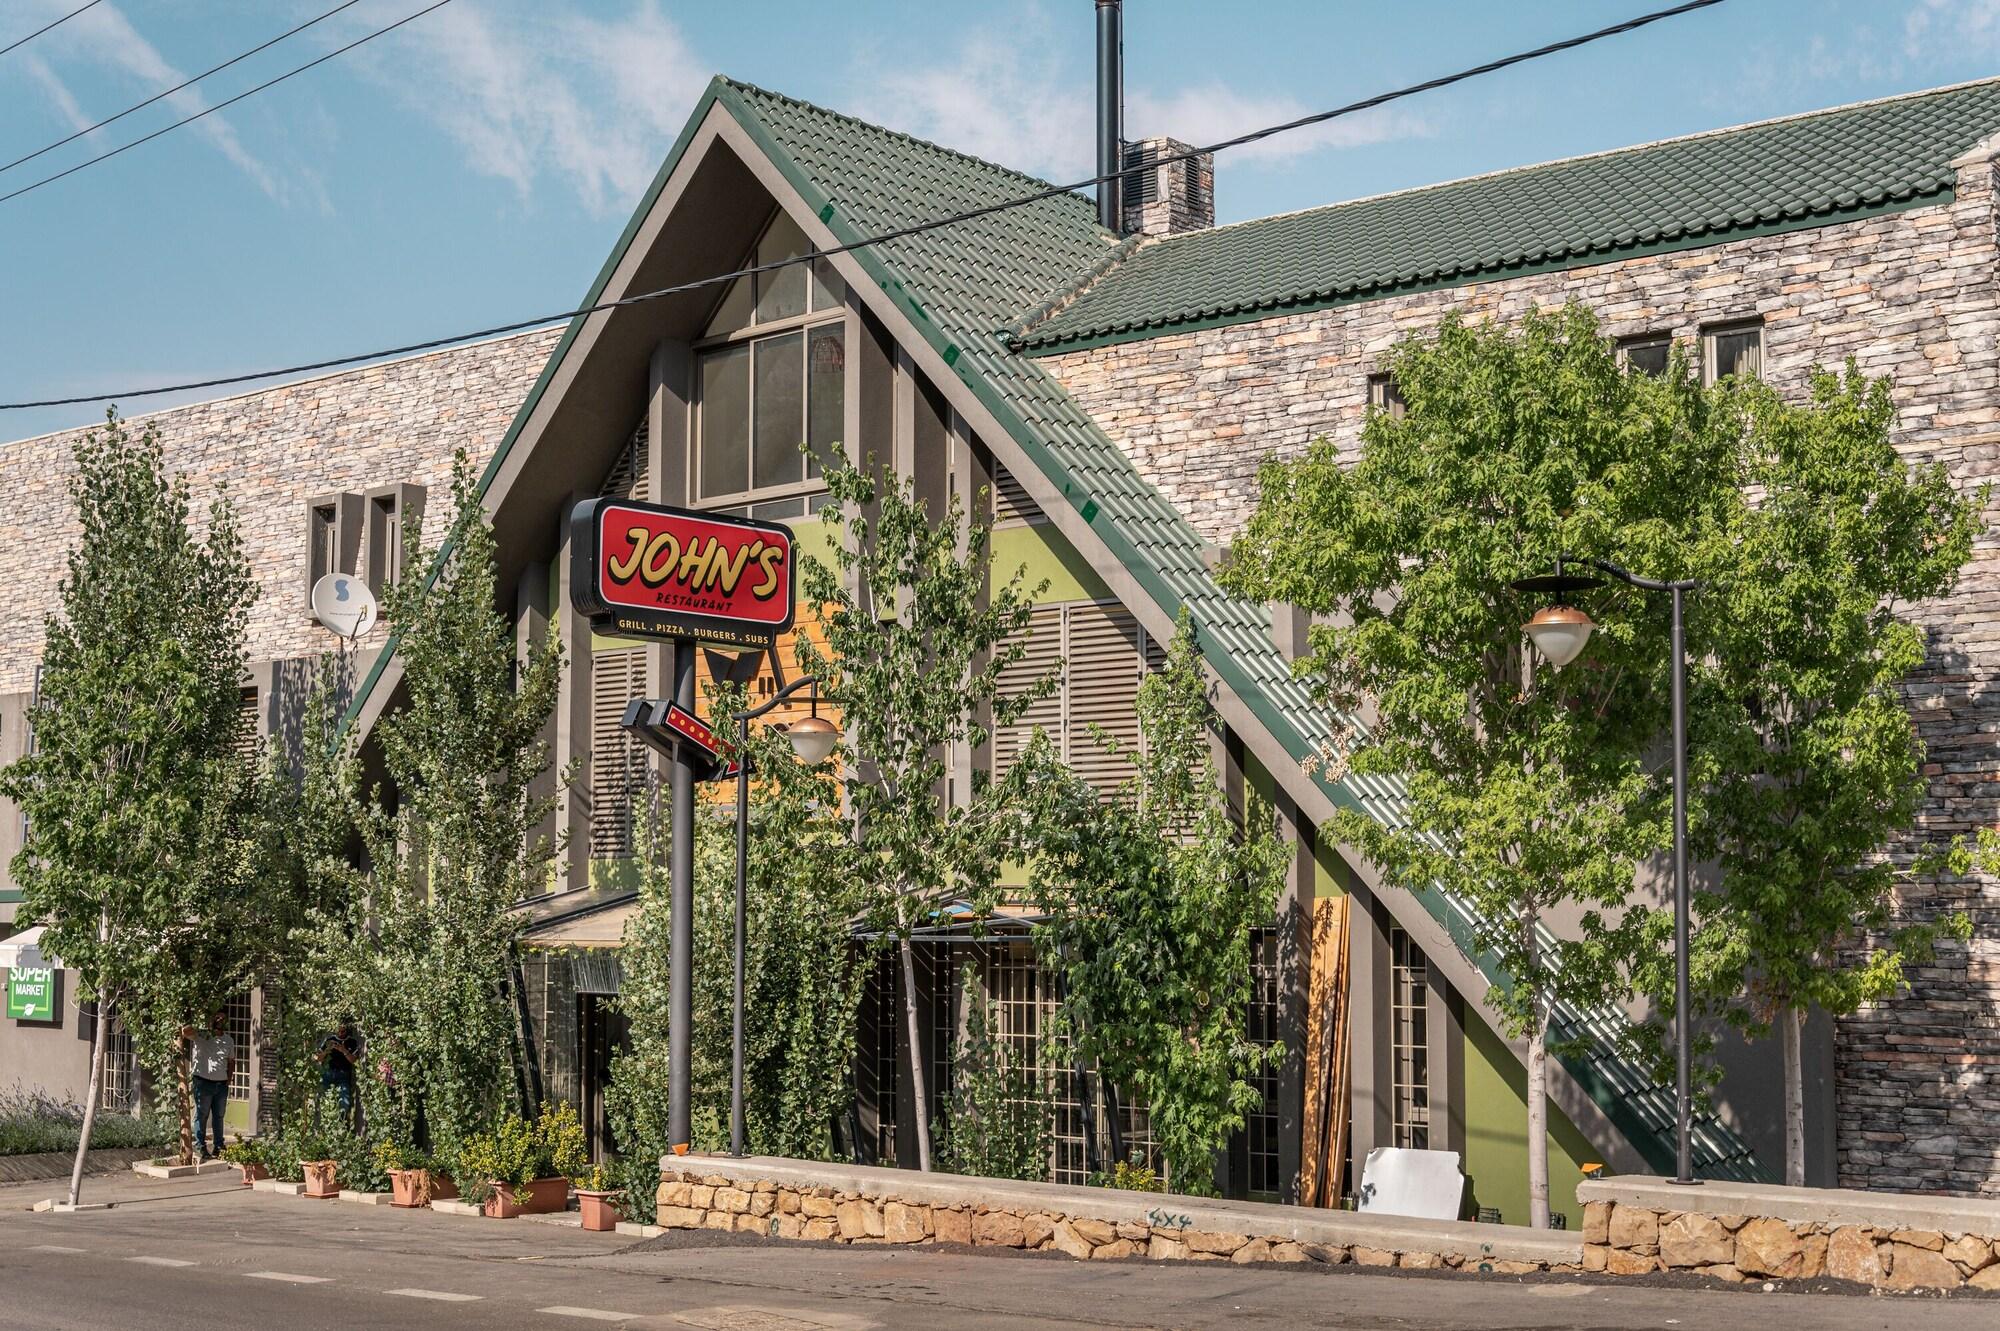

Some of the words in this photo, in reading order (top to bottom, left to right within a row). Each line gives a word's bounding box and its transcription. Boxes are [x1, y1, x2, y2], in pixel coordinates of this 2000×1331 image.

[608, 527, 783, 600] JOHN'S
[656, 592, 733, 611] RESTAURANT
[619, 619, 647, 631] GRILL
[656, 623, 685, 634] PIZZA
[694, 628, 736, 640] BURGERS
[745, 633, 769, 644] SUBS
[10, 967, 51, 982] SUPER
[15, 983, 45, 997] MARKET
